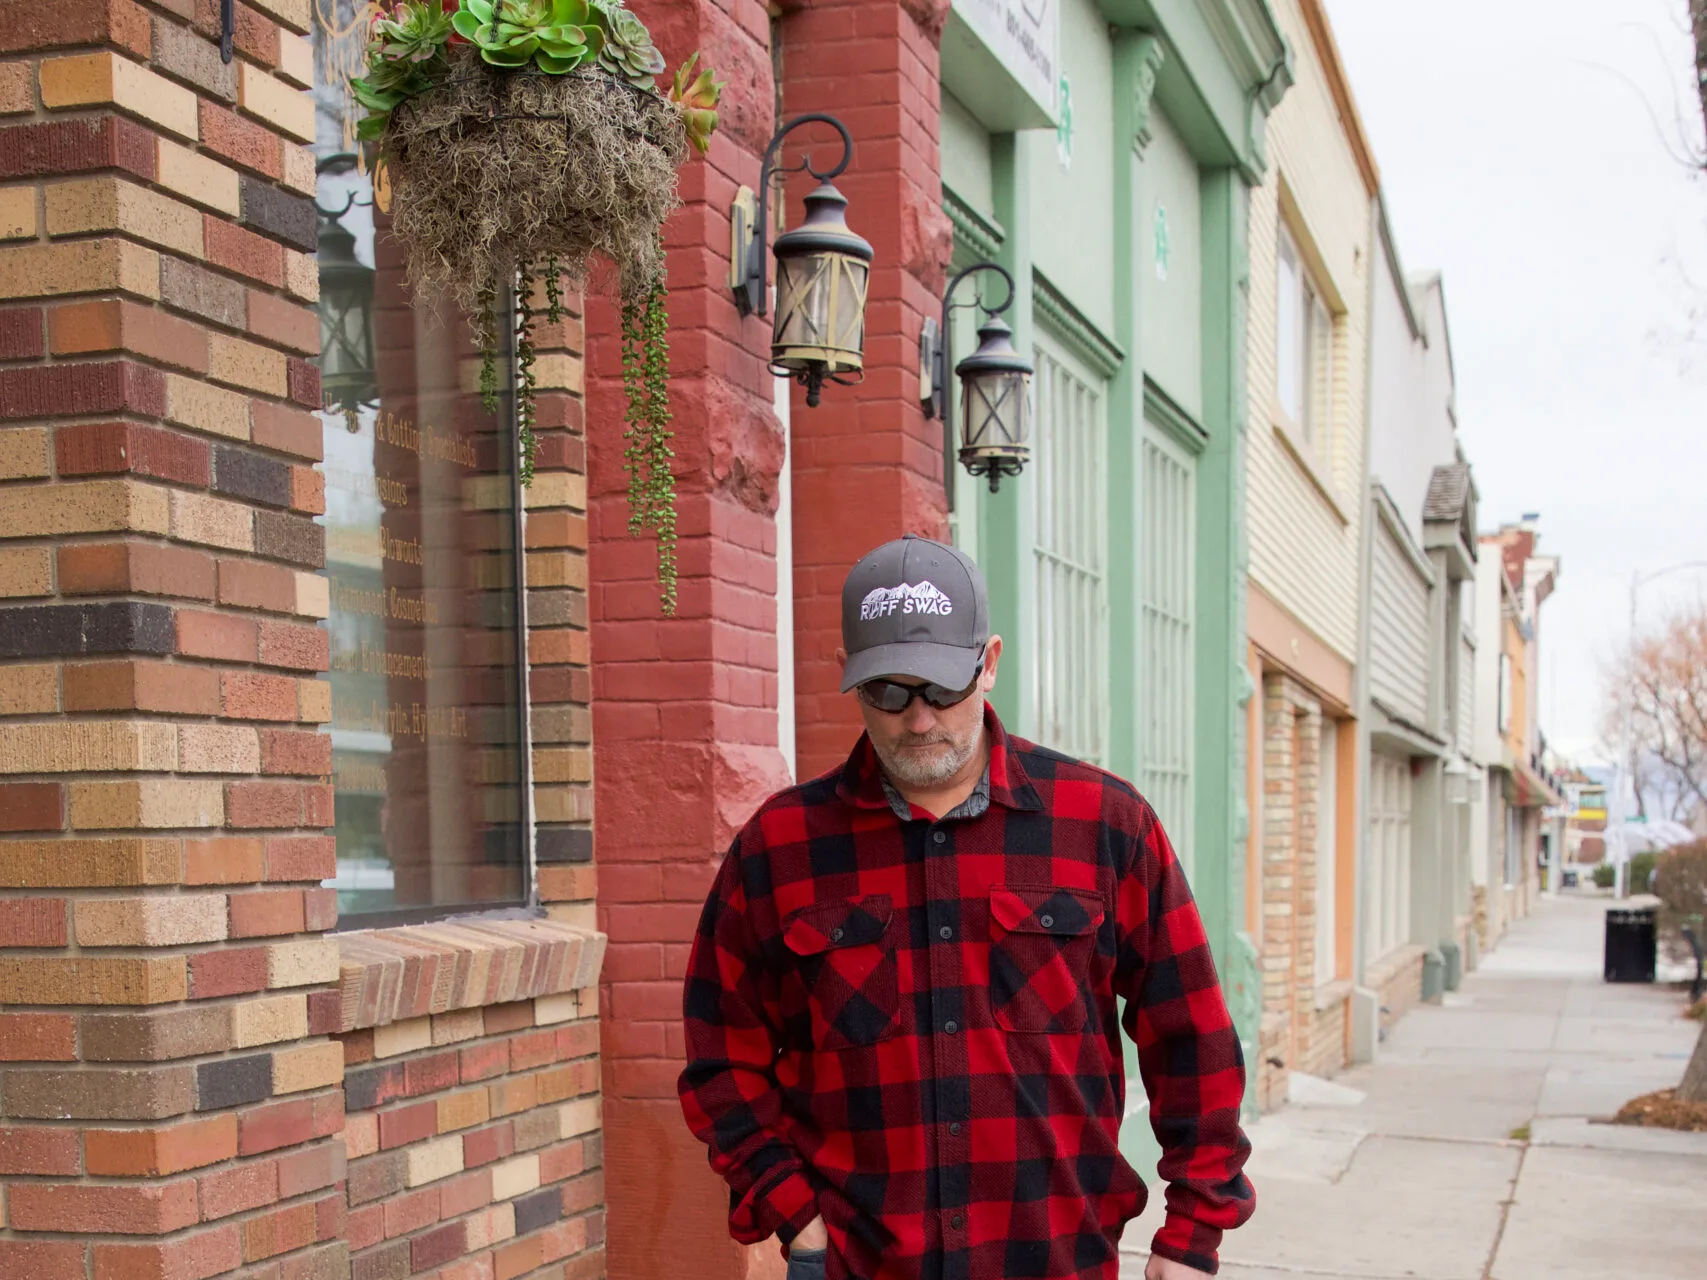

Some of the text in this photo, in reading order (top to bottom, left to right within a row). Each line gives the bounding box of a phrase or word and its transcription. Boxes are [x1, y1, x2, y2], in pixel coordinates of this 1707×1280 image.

[376, 408, 385, 441] &
[387, 412, 424, 460] Cutting
[427, 424, 477, 468] Specialists
[379, 525, 423, 565] Blowouts
[331, 576, 438, 624] Permanent Cosmetics
[860, 598, 953, 621] RUFF SWAG
[361, 640, 432, 681] Enhancements
[450, 705, 468, 738] Art
